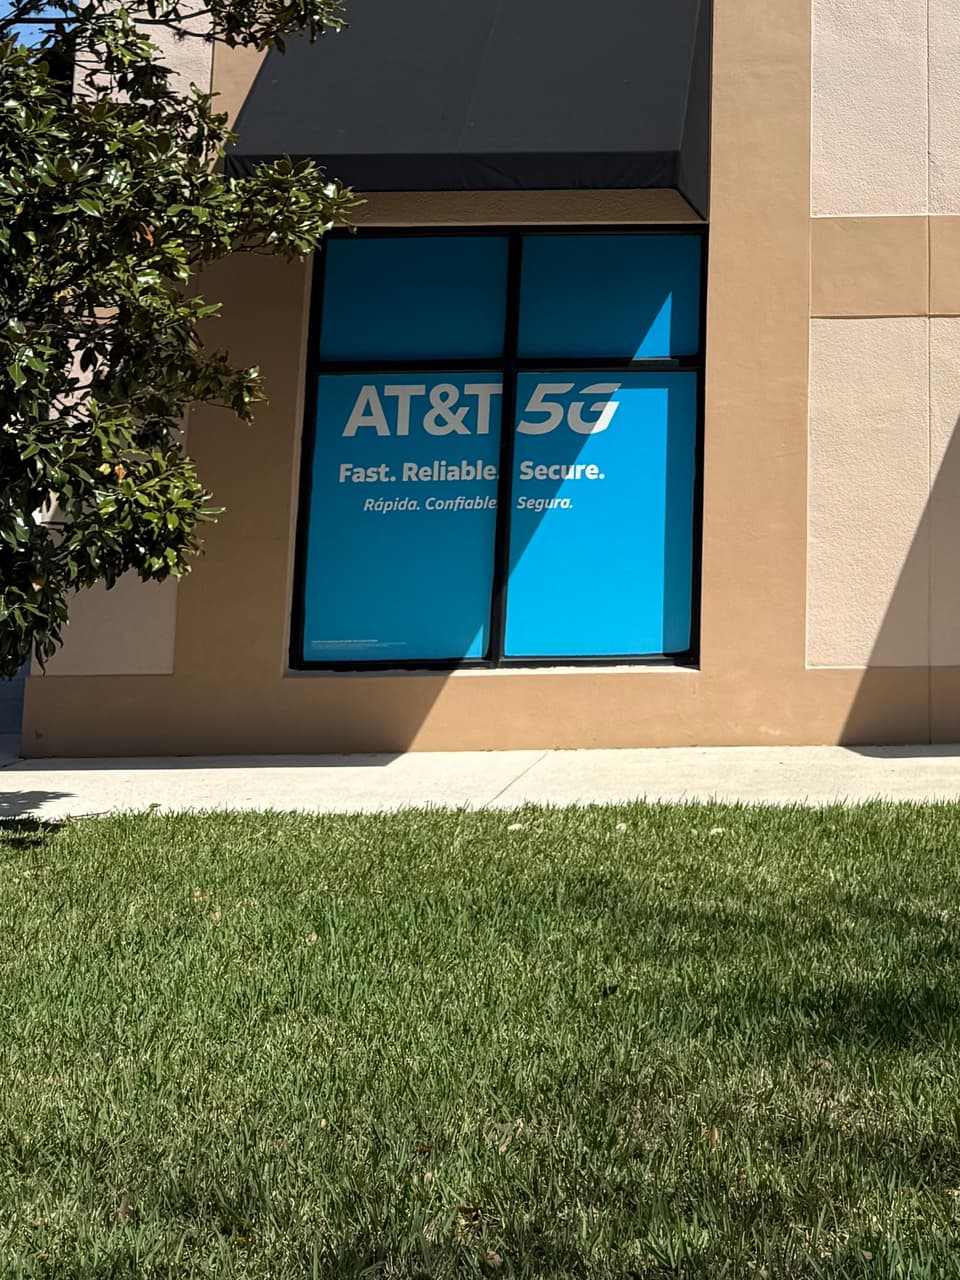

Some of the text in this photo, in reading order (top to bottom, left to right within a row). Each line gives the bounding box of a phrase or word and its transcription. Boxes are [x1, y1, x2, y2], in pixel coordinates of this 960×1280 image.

[342, 383, 622, 437] AT&T 5G
[339, 463, 396, 483] Fast.
[520, 461, 605, 480] Secure.
[364, 496, 574, 514] Rápida. Confiable Segura.
